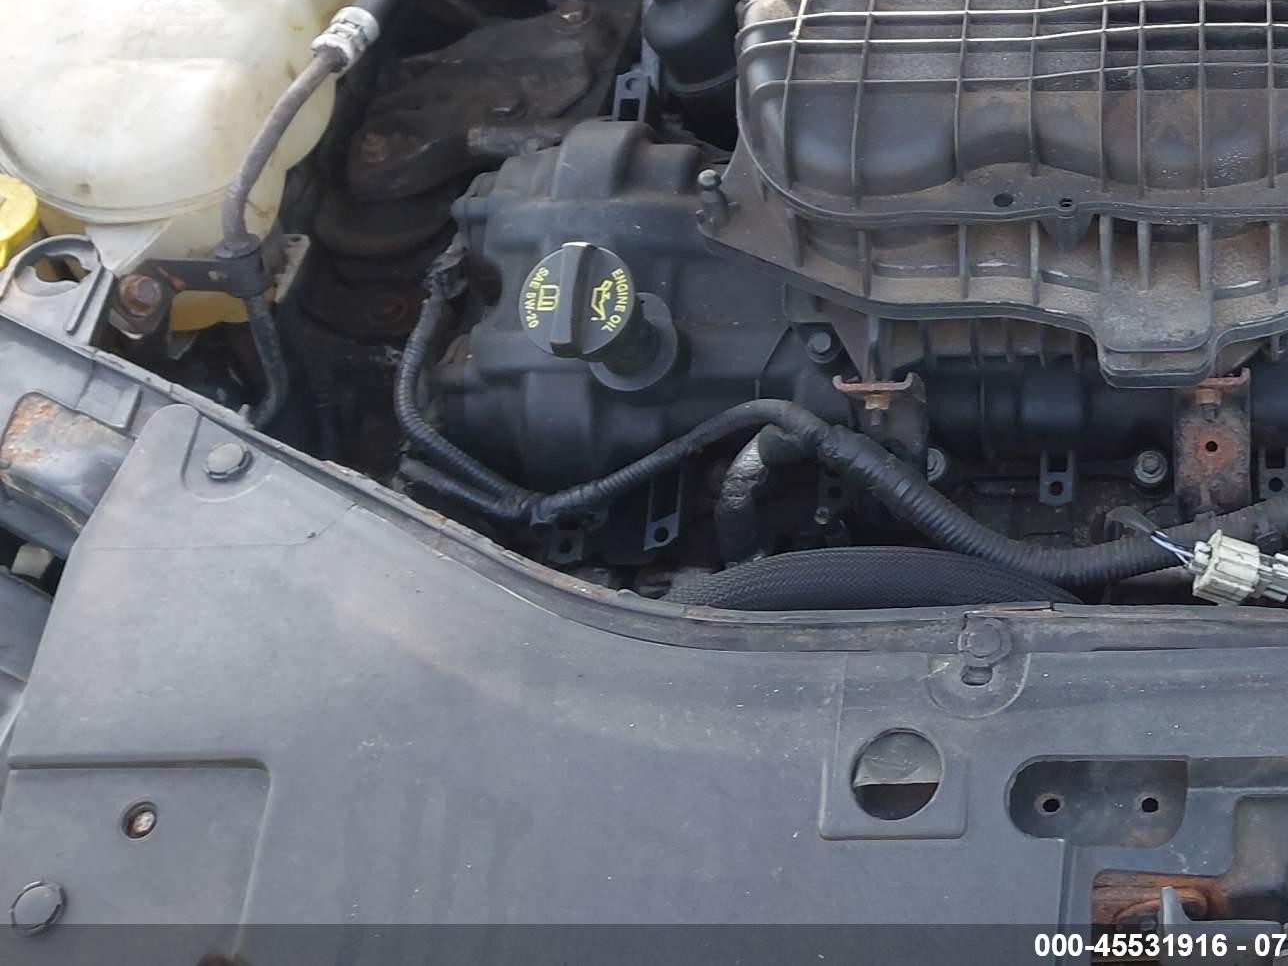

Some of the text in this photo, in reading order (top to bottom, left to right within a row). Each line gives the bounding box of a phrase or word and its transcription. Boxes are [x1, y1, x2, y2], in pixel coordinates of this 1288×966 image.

[528, 267, 549, 289] SAE
[600, 268, 629, 332] ENGINE OIL
